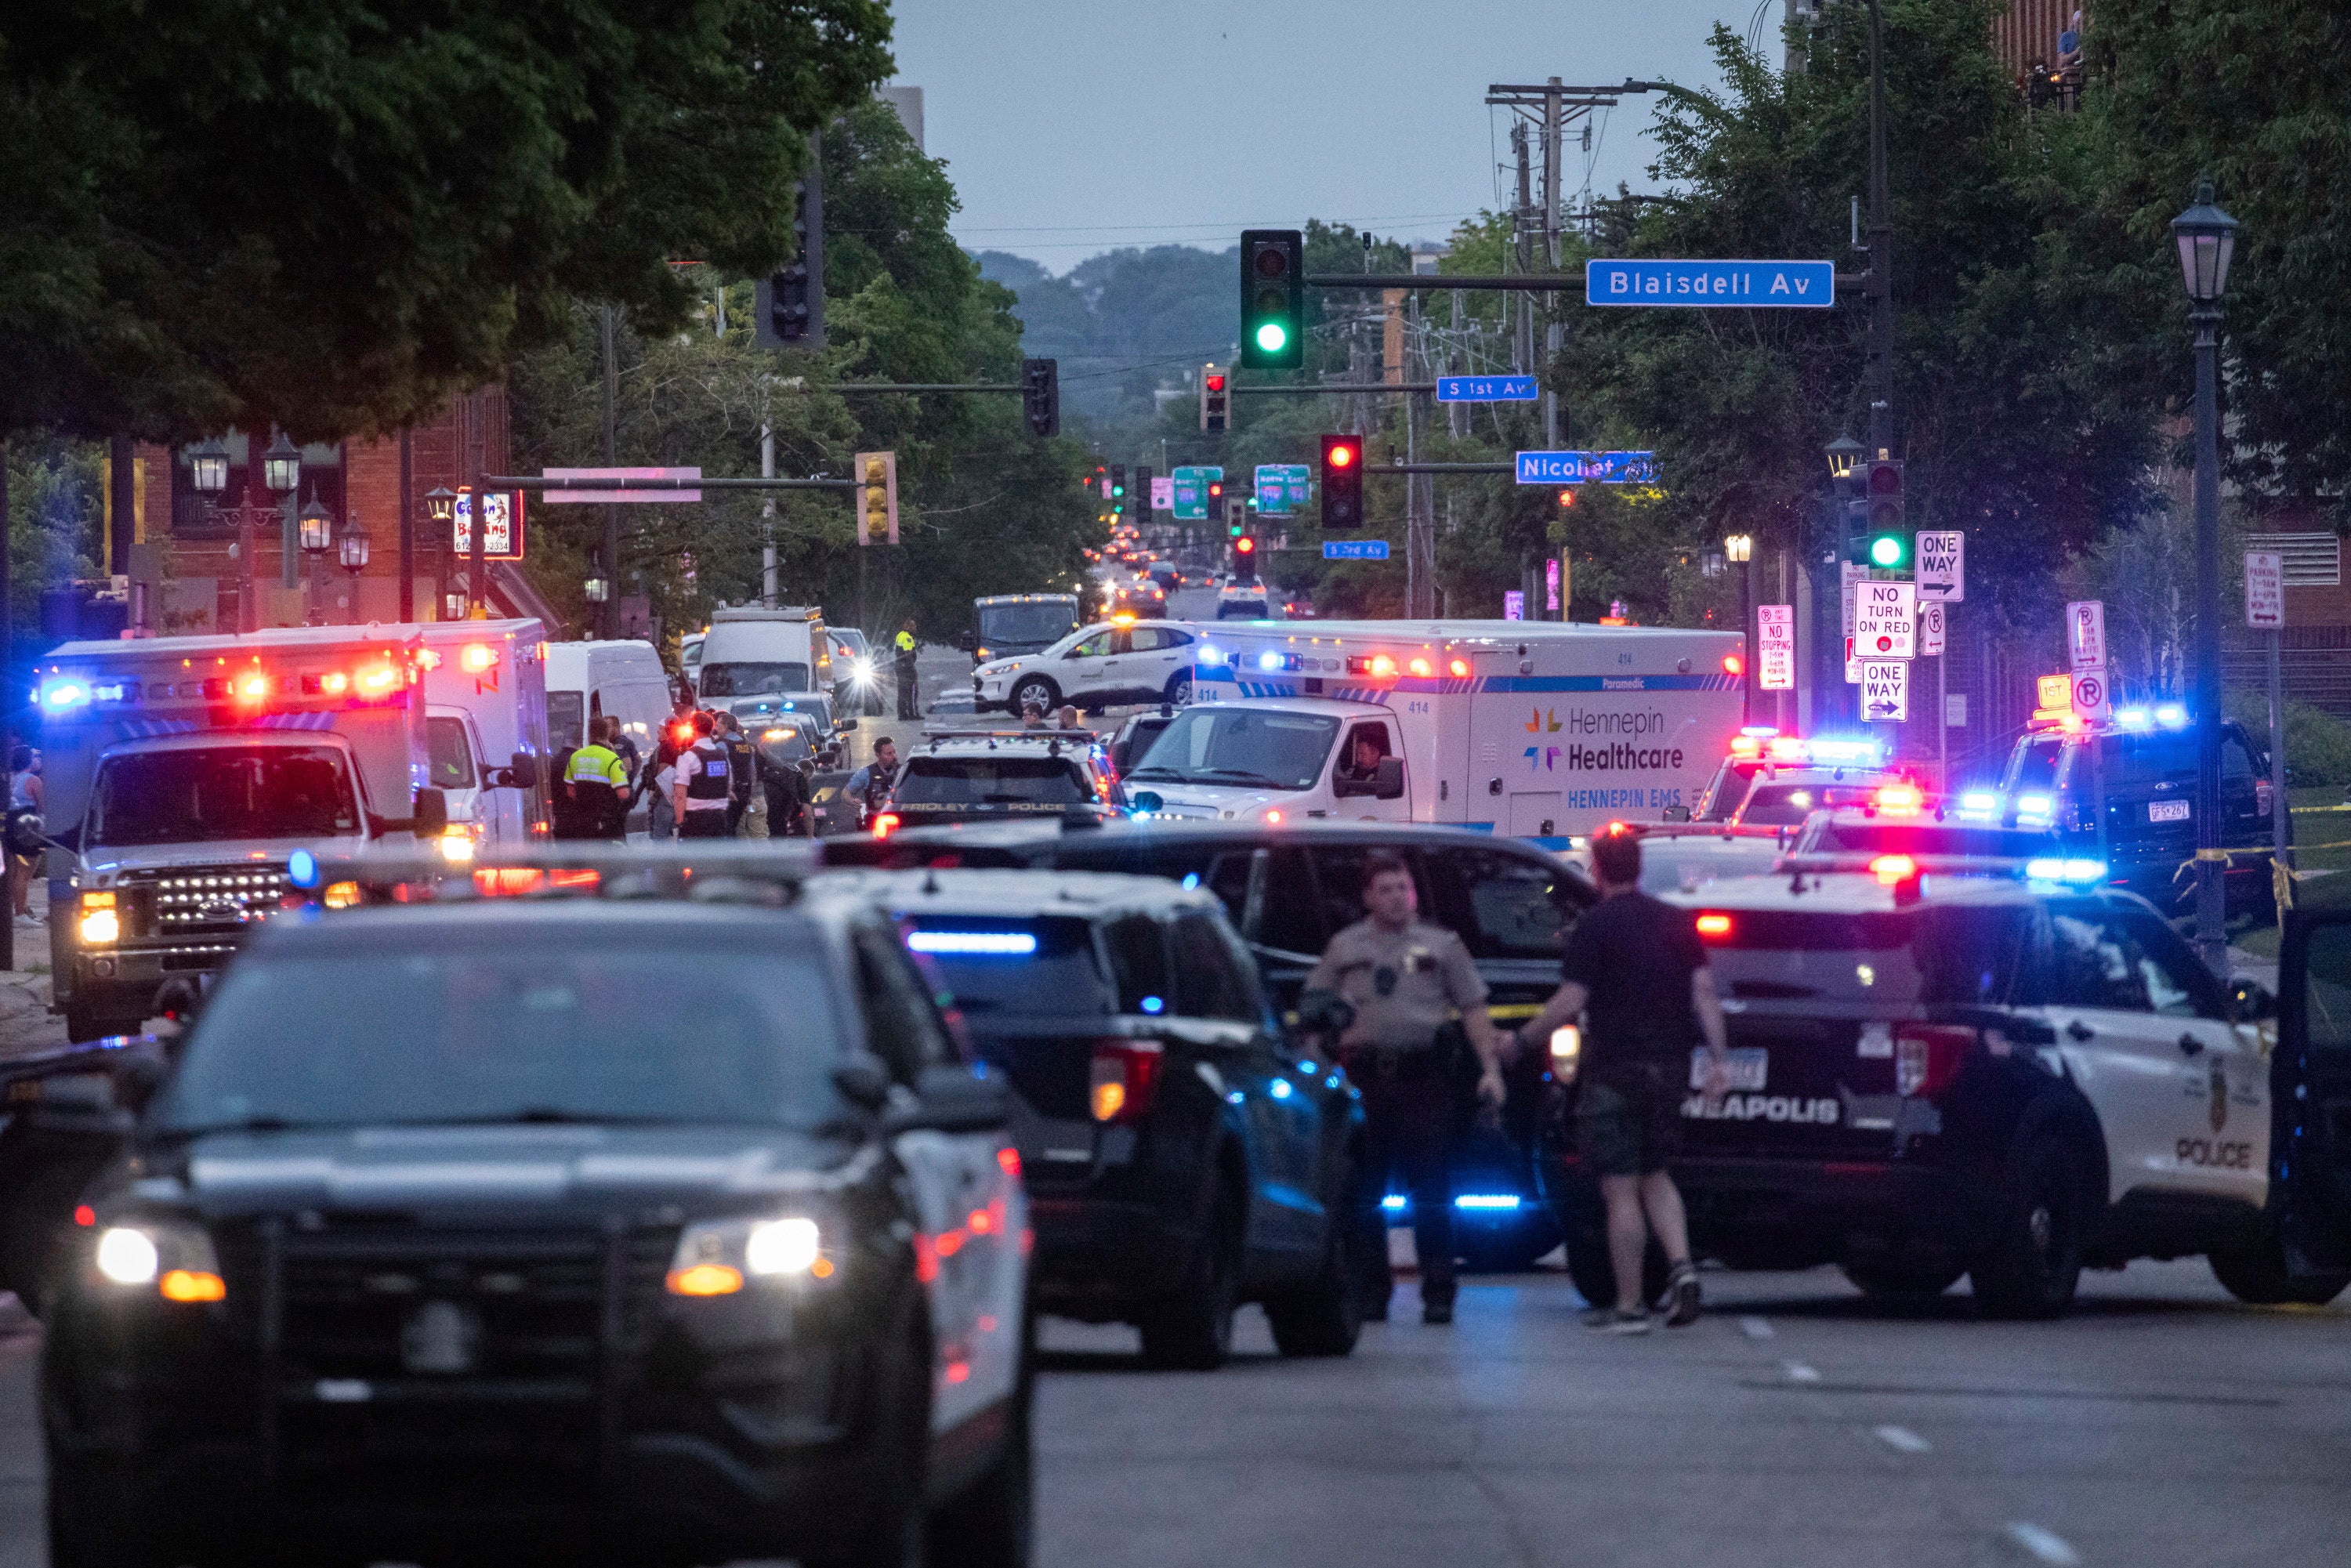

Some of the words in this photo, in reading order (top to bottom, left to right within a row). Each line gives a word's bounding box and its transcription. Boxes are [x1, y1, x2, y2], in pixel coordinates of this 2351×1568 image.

[1610, 272, 1749, 295] Blaisdell
[1770, 273, 1810, 295] Av
[1450, 382, 1459, 395] S
[1469, 382, 1493, 395] 1st
[1504, 382, 1525, 395] Av
[1923, 537, 1957, 552] ONE
[1922, 556, 1958, 572] WAY
[1873, 588, 1898, 602] NO
[1868, 606, 1903, 617] TURN
[1770, 625, 1782, 638] NO
[1860, 621, 1877, 632] ON
[1884, 621, 1910, 633] RED
[1762, 640, 1791, 650] STOPPING
[1617, 653, 1632, 665] 414
[1868, 666, 1900, 679] ONE
[1602, 677, 1644, 689] Paramedic
[1197, 688, 1217, 701] 414
[1867, 683, 1902, 697] WAY
[2044, 685, 2063, 697] 1ST
[1408, 701, 1429, 714] 414
[1570, 706, 1664, 741] Hennepin
[1569, 742, 1683, 770] Healthcare
[1568, 788, 1644, 809] HENNEPIN
[1650, 788, 1681, 807] EMS
[900, 802, 969, 812] FRIDLEY
[1008, 802, 1067, 812] POLICE
[2177, 1136, 2251, 1169] POLICE
